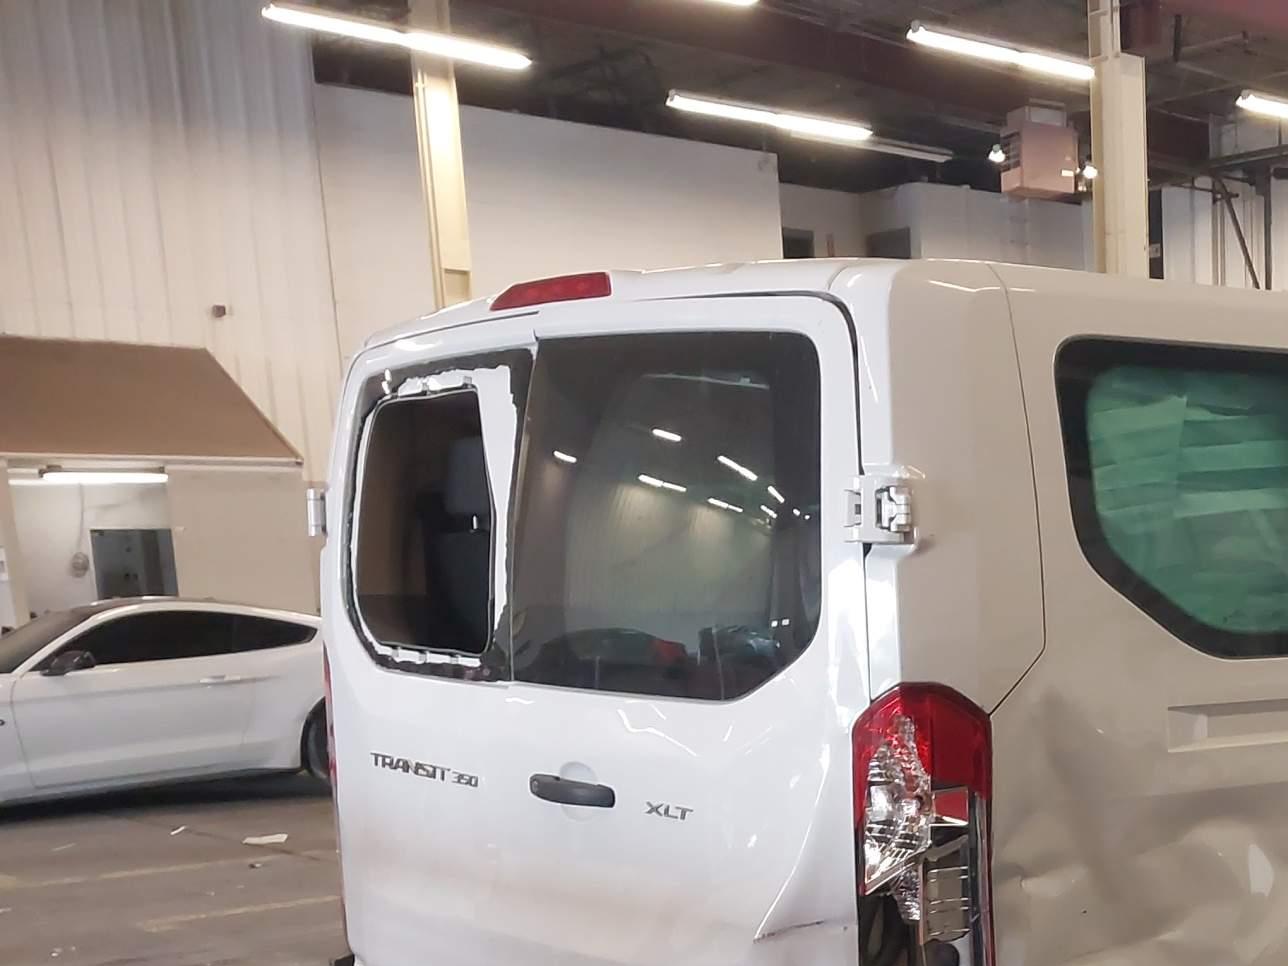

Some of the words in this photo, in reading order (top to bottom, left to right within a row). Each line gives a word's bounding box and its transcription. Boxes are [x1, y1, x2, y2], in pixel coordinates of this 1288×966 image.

[370, 752, 451, 781] TRANSIT
[452, 771, 479, 787] 350
[645, 802, 693, 821] XLT
